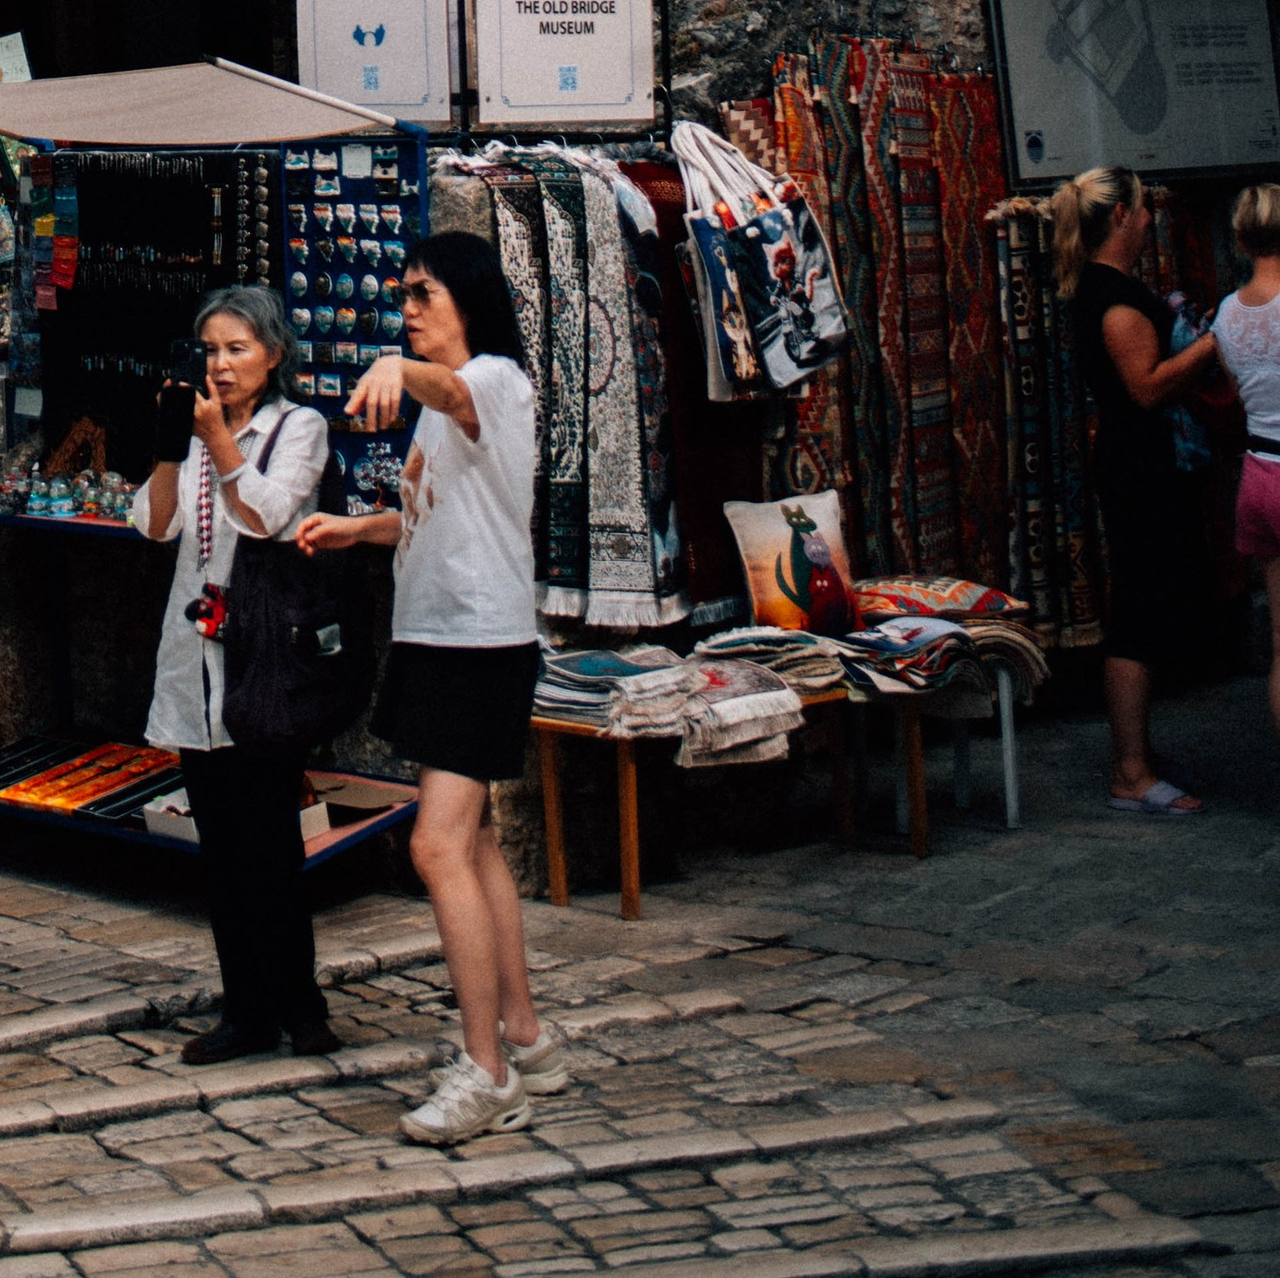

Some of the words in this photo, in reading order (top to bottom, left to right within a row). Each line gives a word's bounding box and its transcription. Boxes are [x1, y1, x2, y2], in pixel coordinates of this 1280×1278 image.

[516, 0, 540, 15] THE
[542, 0, 569, 15] OLD
[571, 0, 617, 15] BRIDGE
[538, 21, 595, 35] MUSEUM
